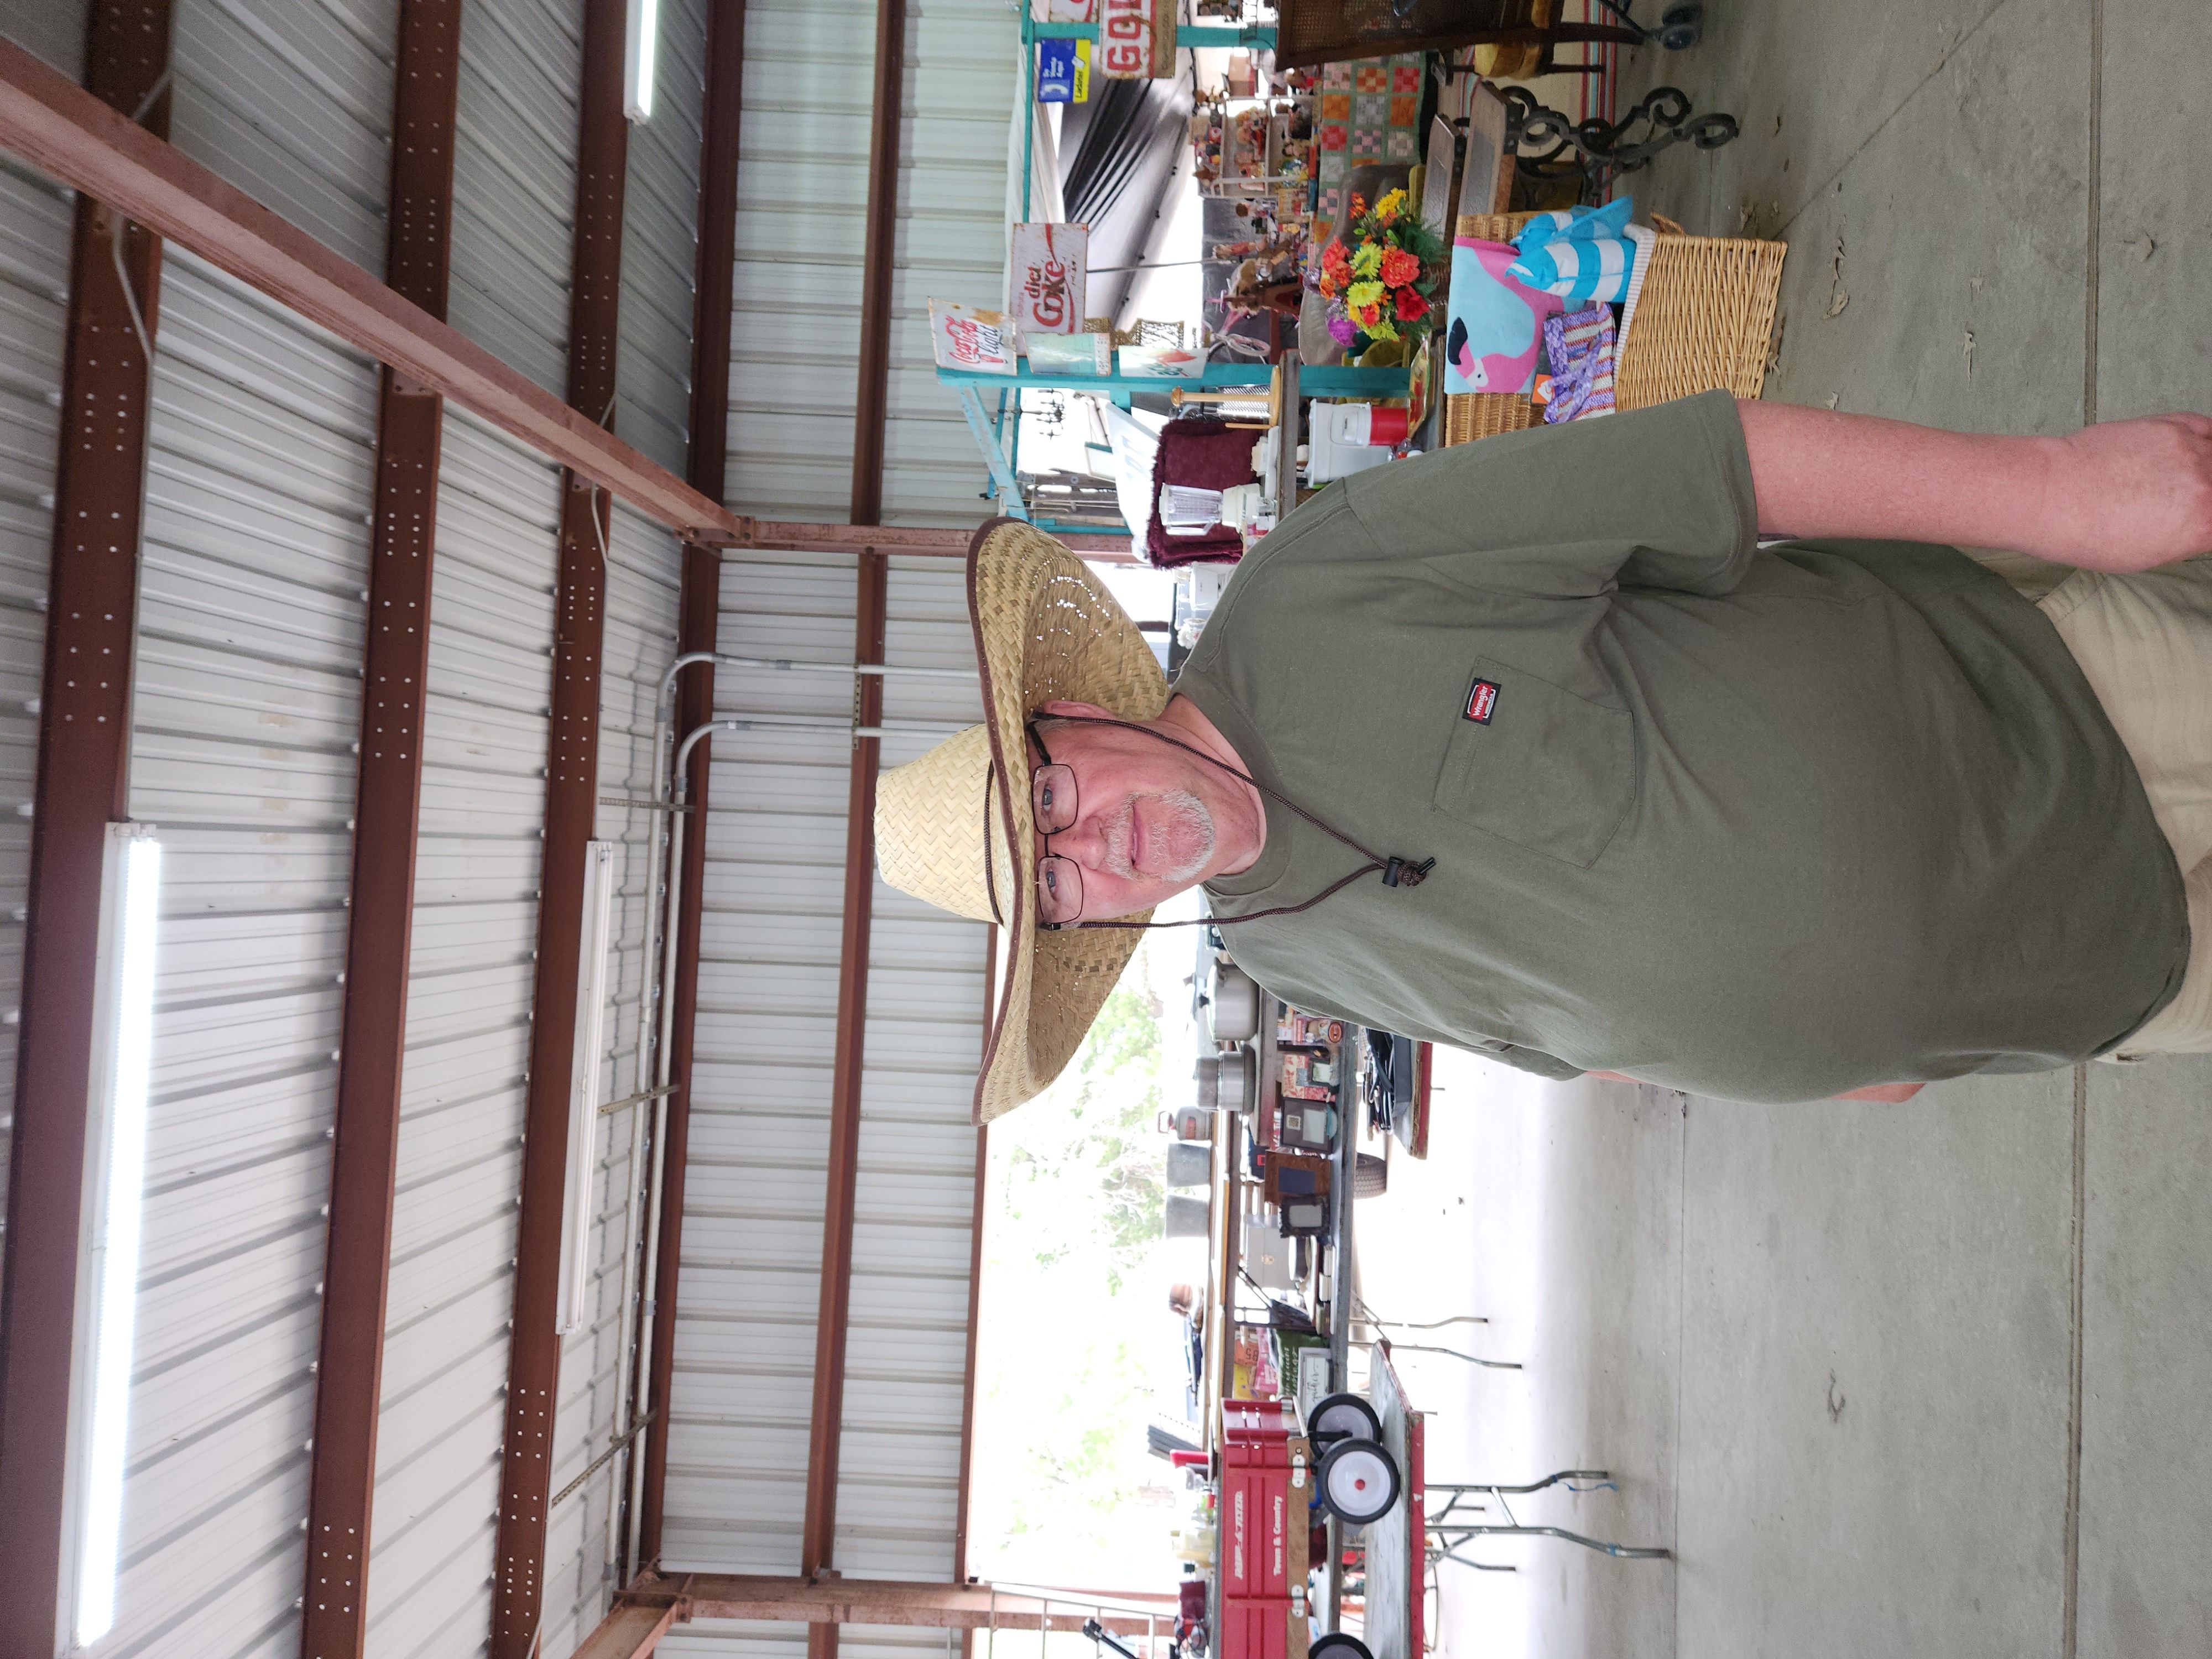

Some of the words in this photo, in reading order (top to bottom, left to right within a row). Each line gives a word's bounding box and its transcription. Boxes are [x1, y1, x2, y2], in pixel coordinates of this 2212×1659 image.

[1024, 266, 1041, 299] diet
[1032, 261, 1065, 327] Coke
[975, 326, 1004, 354] light
[1473, 686, 1488, 716] Wrangler
[1272, 1495, 1283, 1535] Country
[1272, 1536, 1281, 1546] &
[1273, 1548, 1281, 1576] Town
